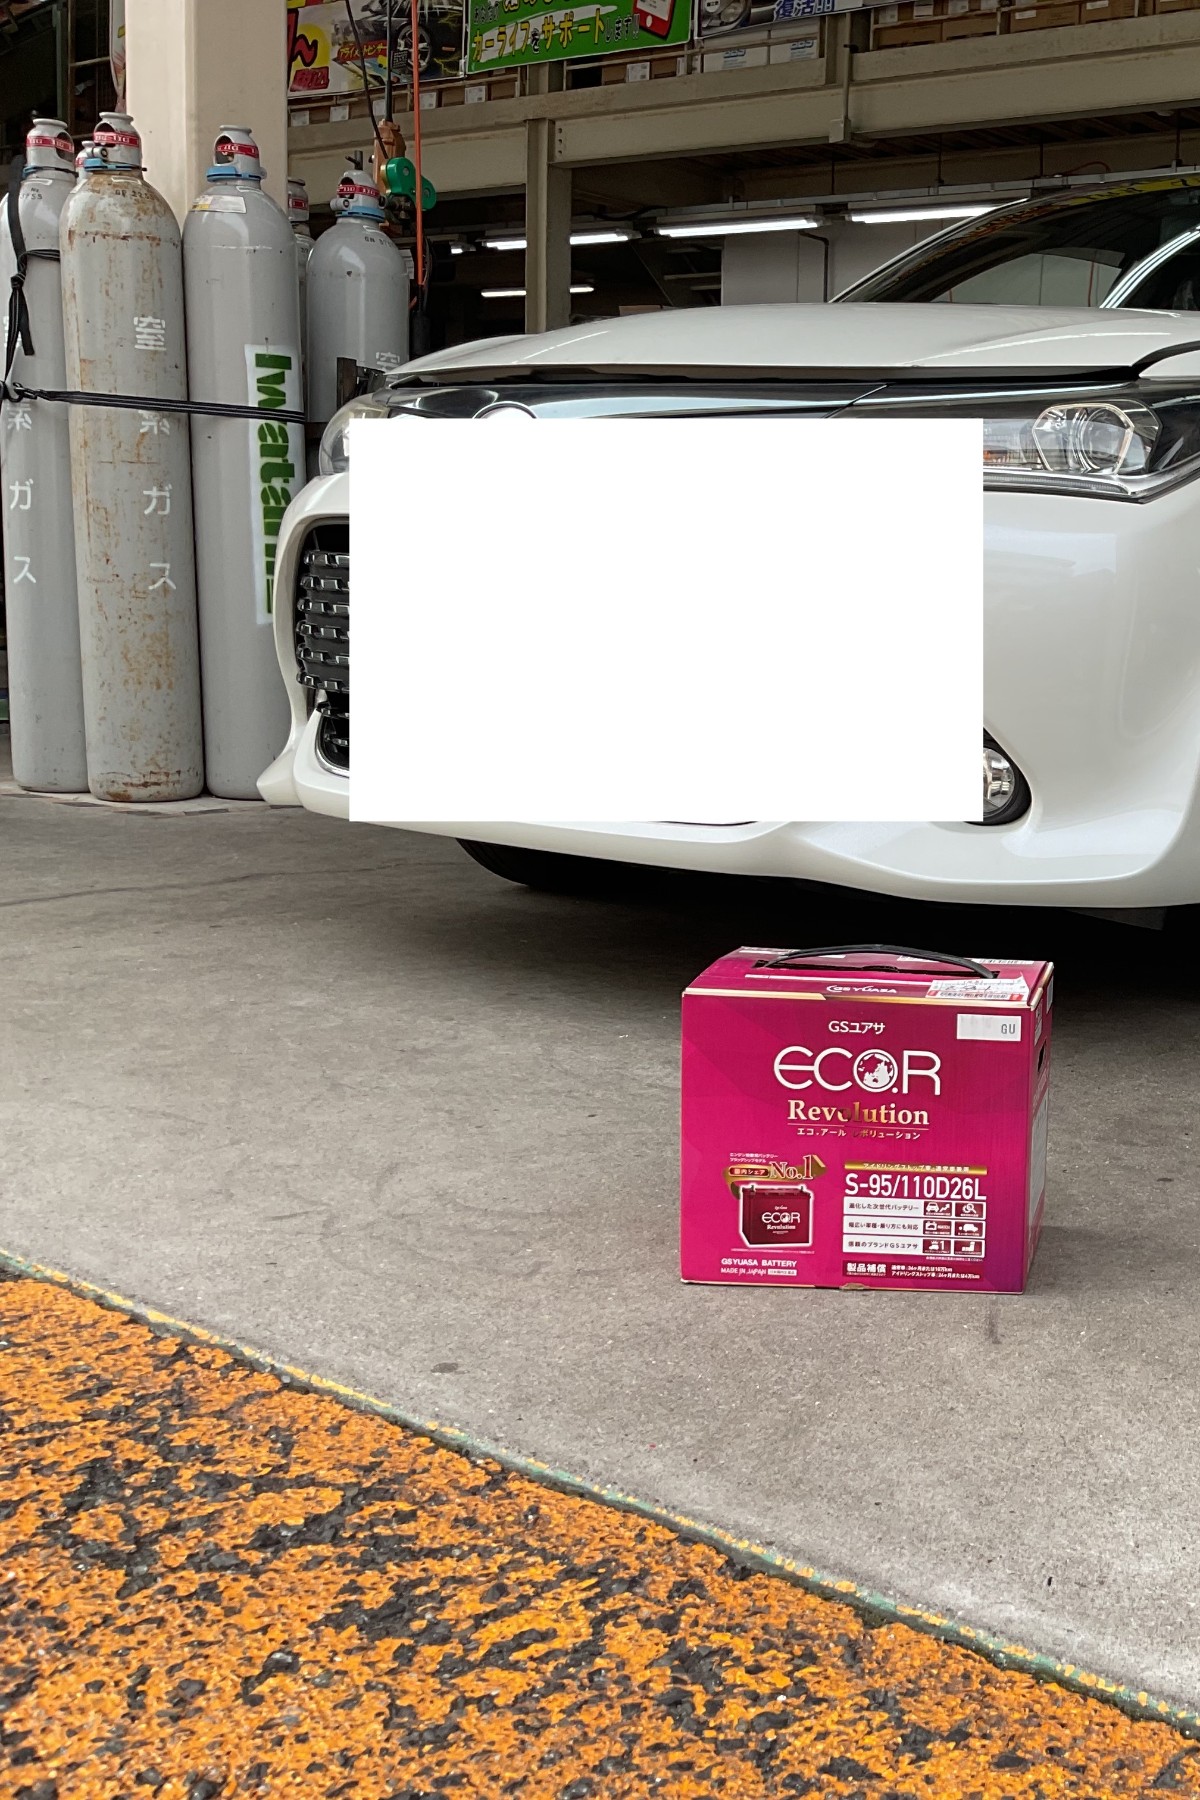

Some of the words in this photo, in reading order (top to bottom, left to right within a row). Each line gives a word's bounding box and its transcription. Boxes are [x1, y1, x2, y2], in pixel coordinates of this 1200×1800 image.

[828, 1020, 885, 1035] GSユアサ
[787, 1099, 930, 1125] Revolution
[769, 1154, 814, 1180] No.1
[844, 1173, 987, 1200] S-95/110D26L
[762, 1259, 798, 1268] BATTERY
